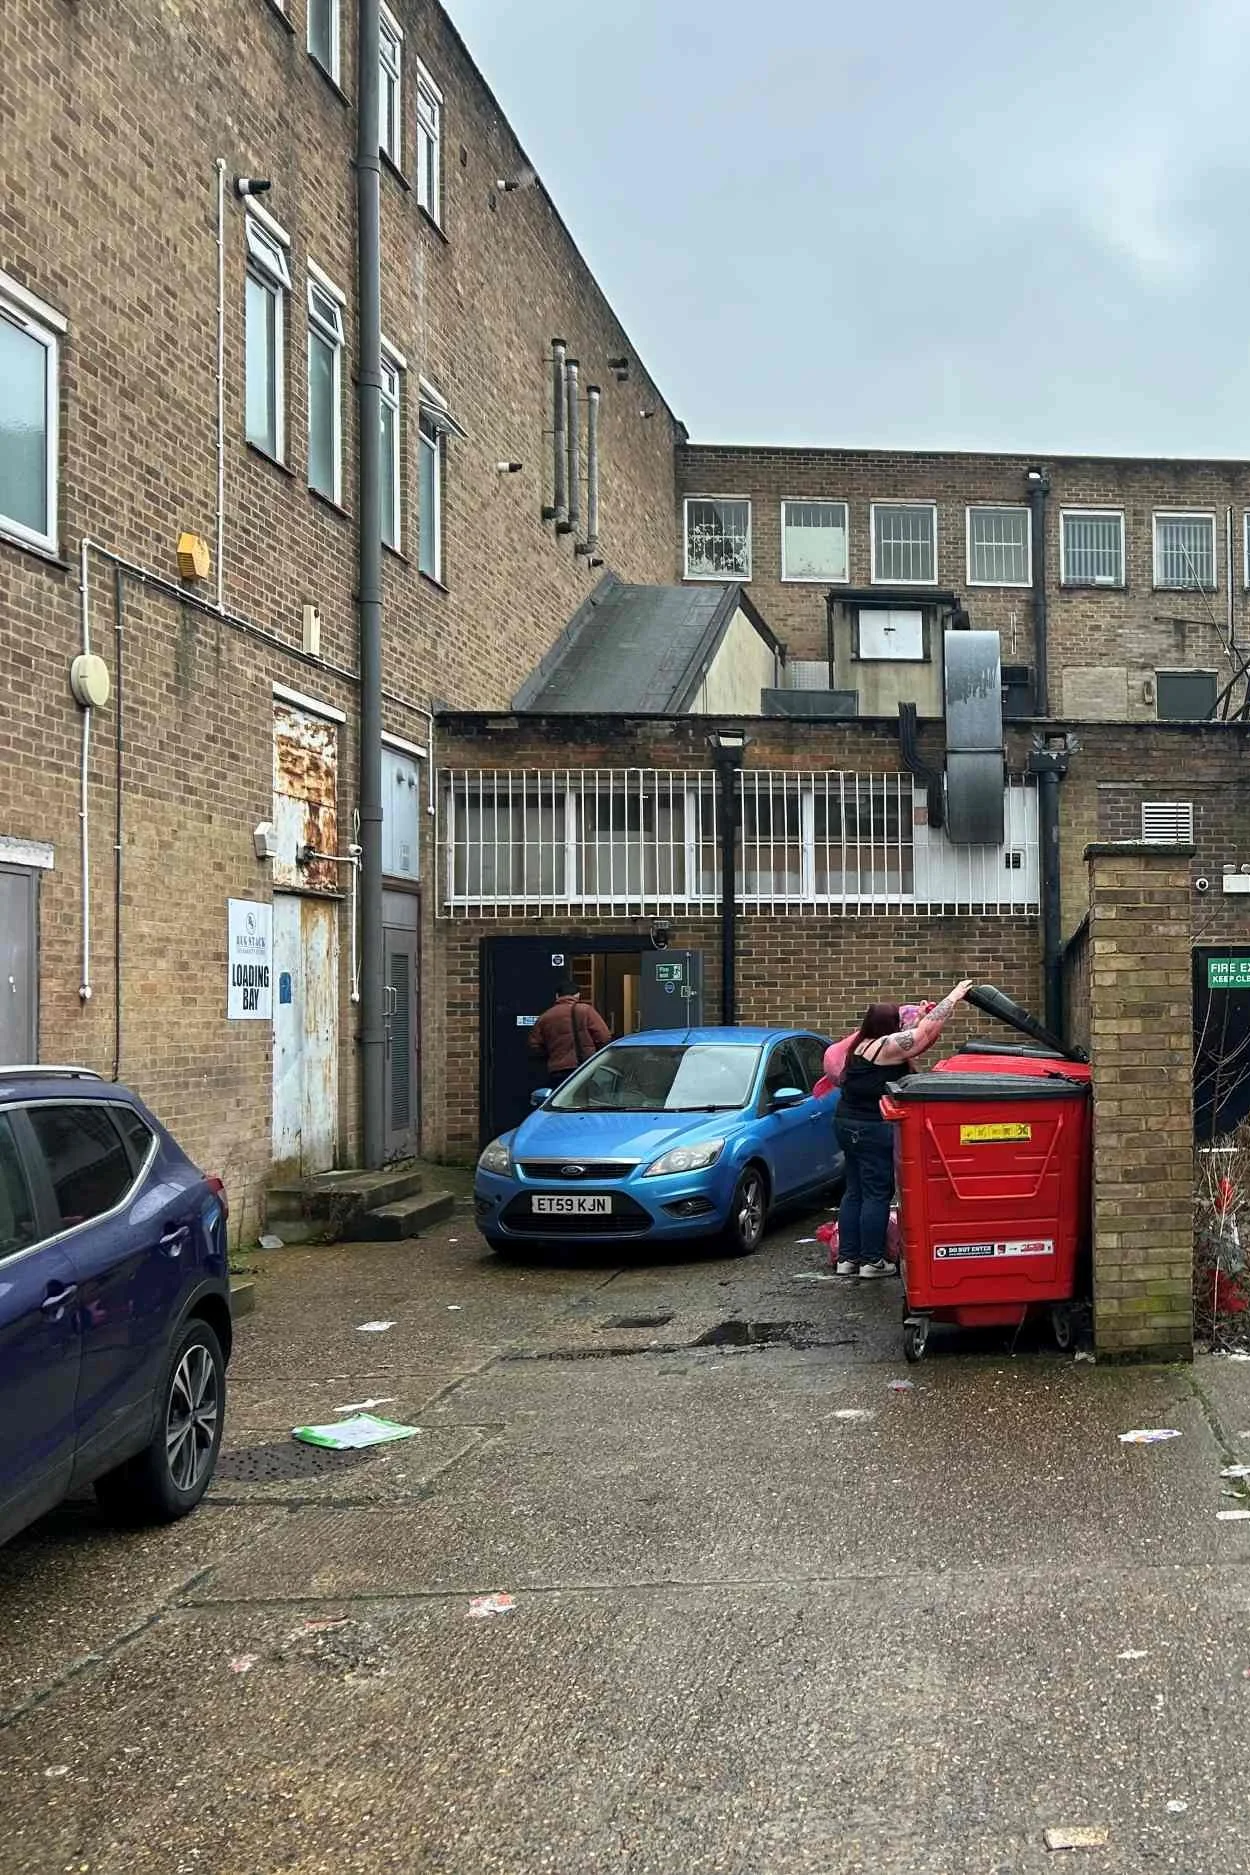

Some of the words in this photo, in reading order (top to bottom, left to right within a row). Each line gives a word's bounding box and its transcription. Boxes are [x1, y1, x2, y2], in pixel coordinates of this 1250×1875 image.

[1210, 963, 1236, 973] FIRE
[232, 963, 270, 988] LOADING
[1212, 975, 1235, 983] KEEP
[242, 988, 259, 1011] BAY
[537, 1198, 574, 1212] ET59
[577, 1198, 606, 1212] KJN
